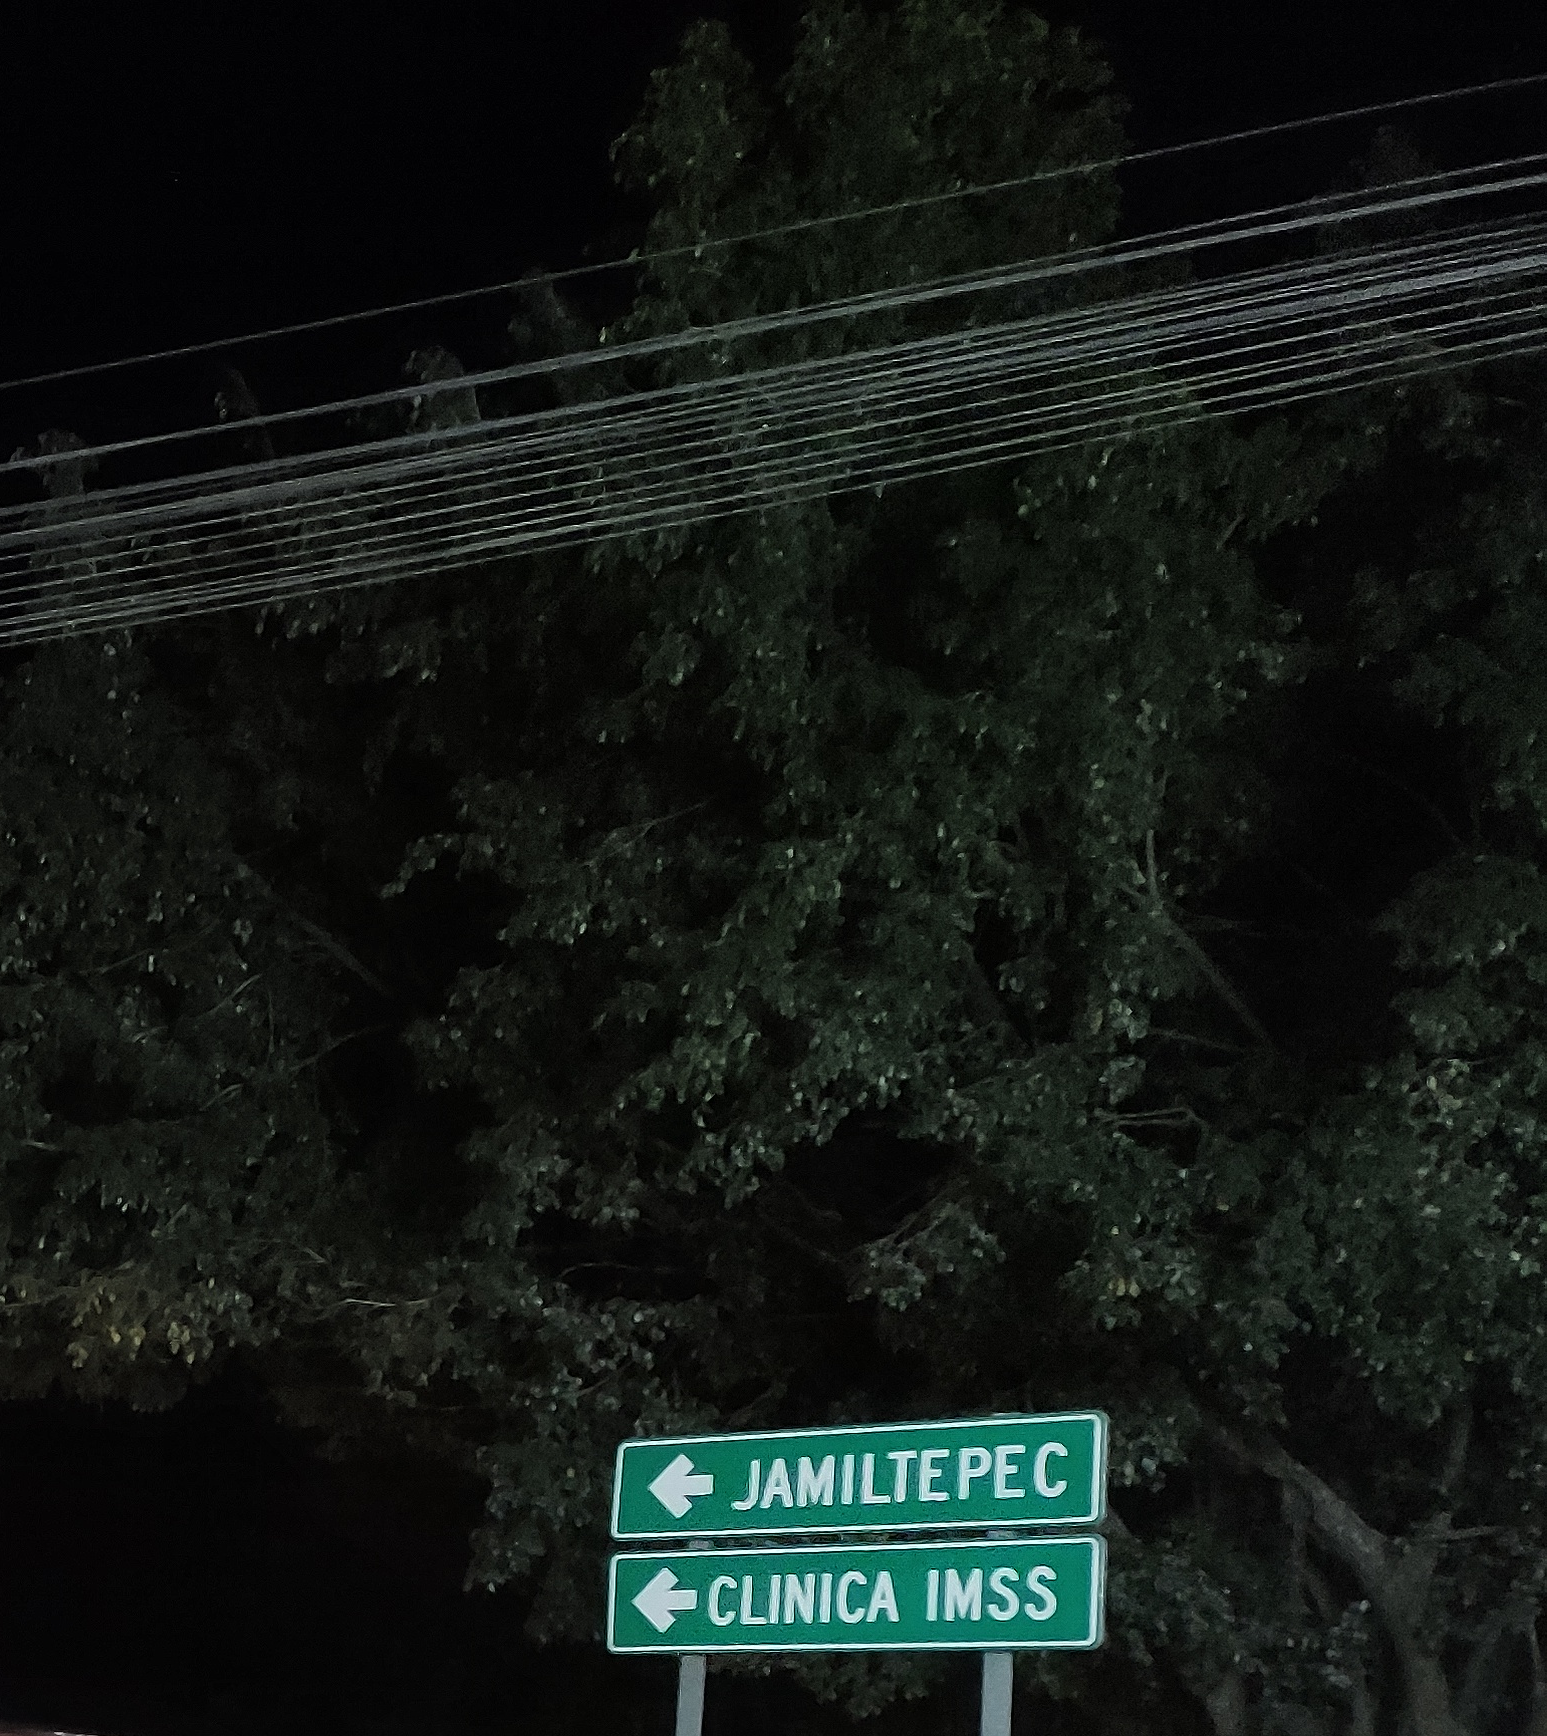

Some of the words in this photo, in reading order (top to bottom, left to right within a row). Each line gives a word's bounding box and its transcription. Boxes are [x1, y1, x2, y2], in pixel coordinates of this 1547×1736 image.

[731, 1442, 1068, 1510] JAMILTEPEC
[707, 1570, 899, 1627] CLINICA
[925, 1565, 1058, 1623] IMSS
